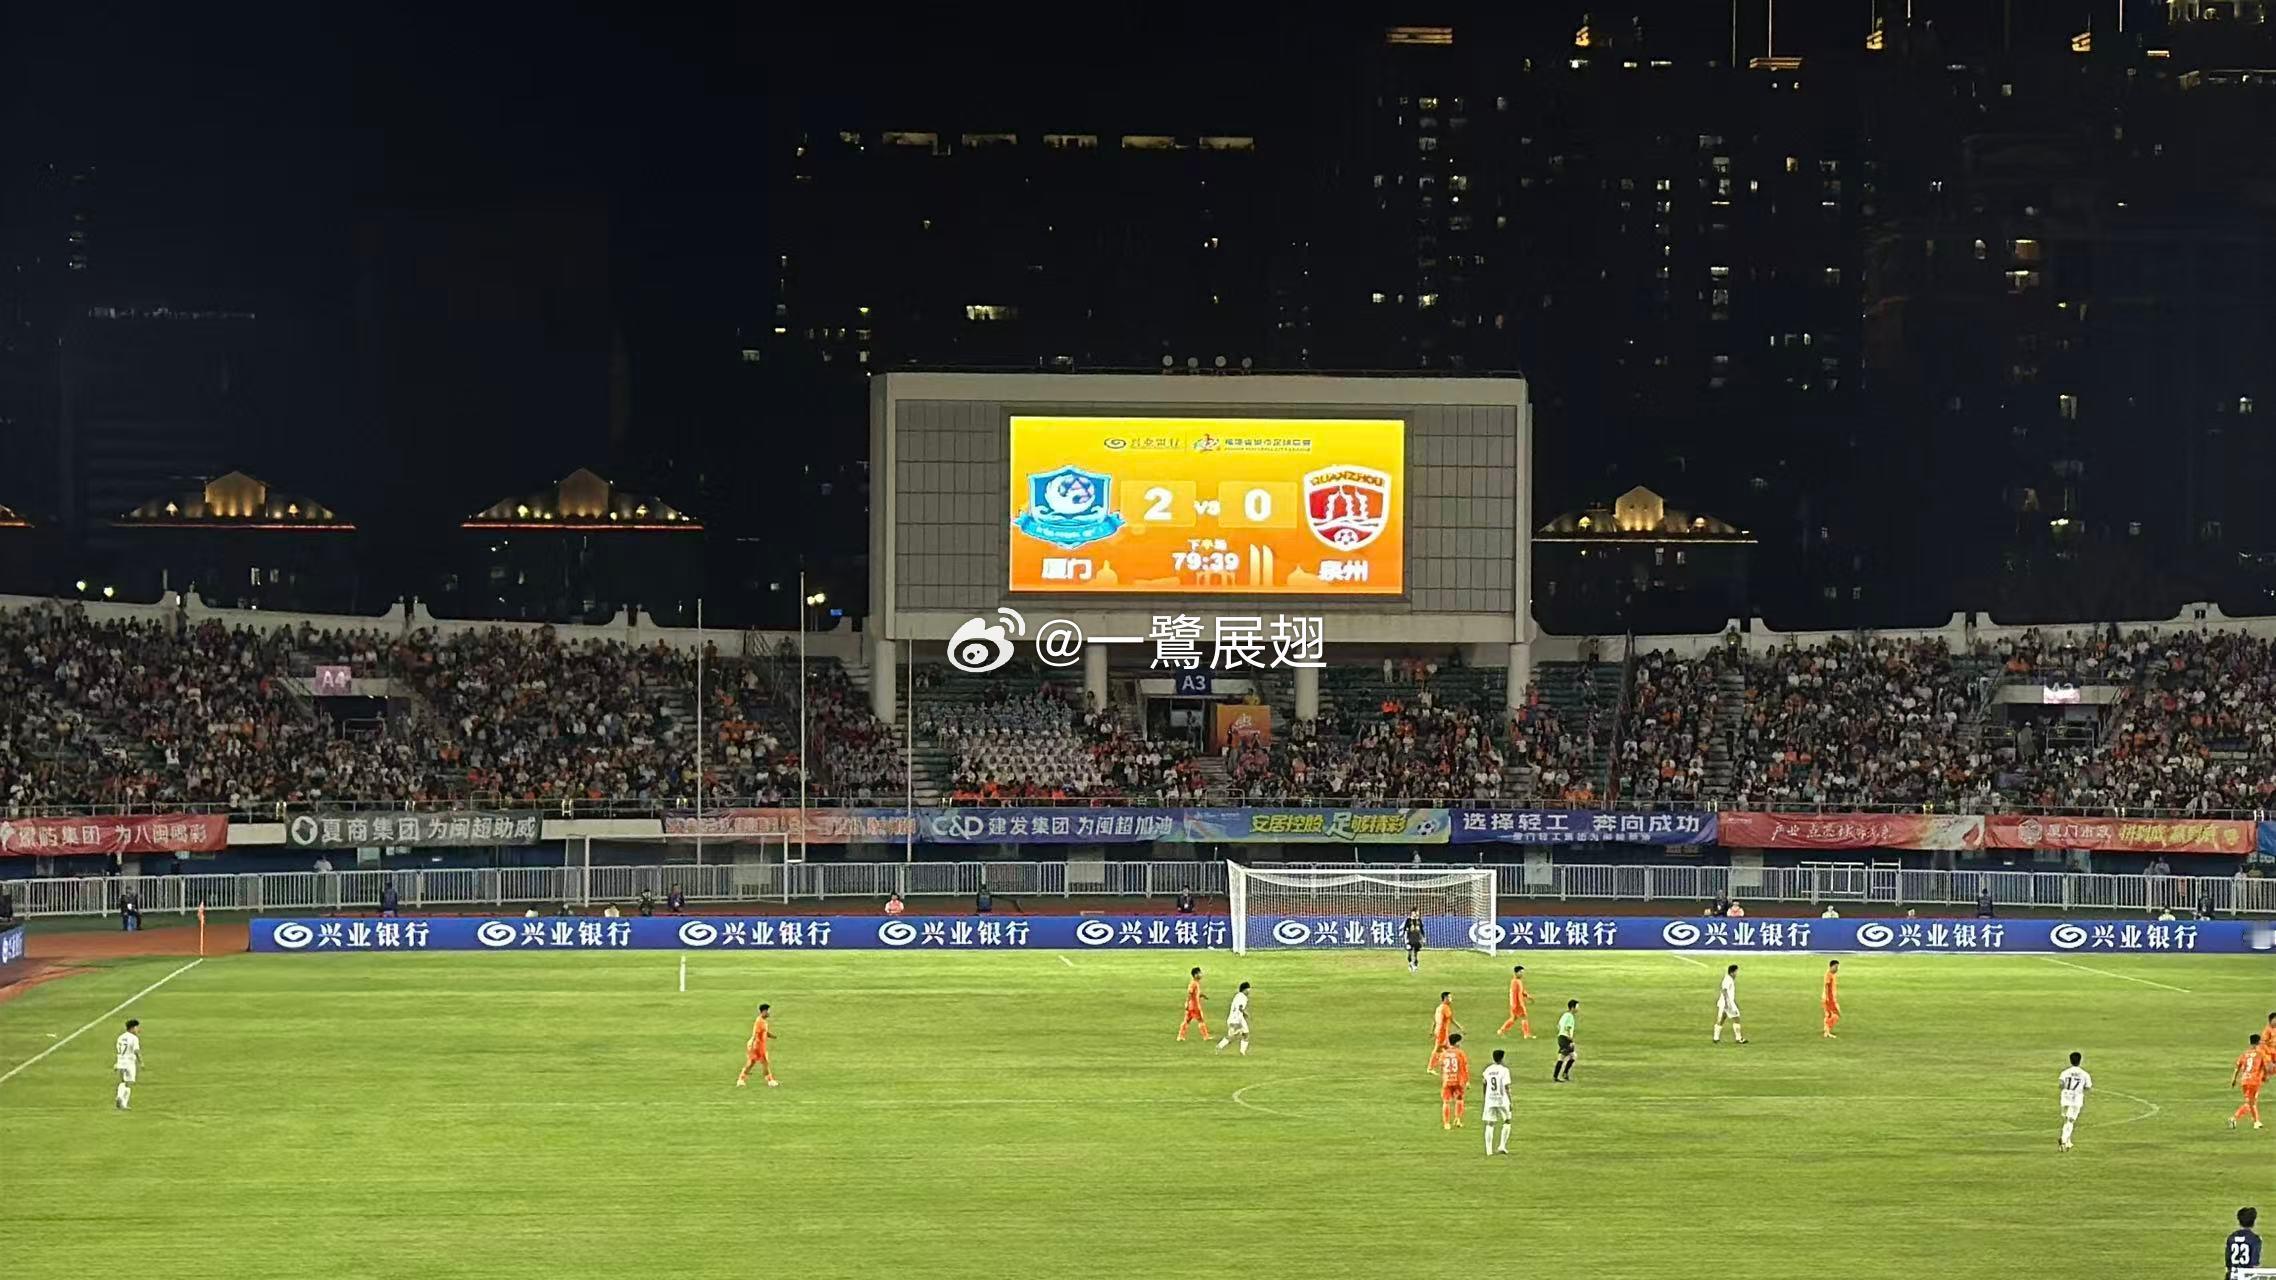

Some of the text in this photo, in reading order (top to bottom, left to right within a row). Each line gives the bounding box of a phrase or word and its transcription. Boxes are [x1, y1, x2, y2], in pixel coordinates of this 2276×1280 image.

[1311, 471, 1384, 486] QUANZHOU
[1144, 488, 1172, 521] 2
[1244, 489, 1271, 521] 0
[1172, 552, 1239, 572] 79:39
[322, 670, 346, 688] A4
[1182, 674, 1206, 690] A3
[321, 816, 536, 842] 夏商集团 为闽超助威
[932, 815, 984, 839] C&D
[988, 816, 1069, 836] 建发集团
[1077, 815, 1173, 837] 为闽超加油
[1251, 811, 1407, 840] 安居控股 足够精彩
[1463, 813, 1700, 833] 选择轻工 奔向成功
[318, 922, 429, 947] 兴业银行
[521, 922, 632, 946] 兴业银行
[722, 921, 831, 946] 兴业银行
[921, 921, 1030, 946] 兴业银行
[1118, 920, 1226, 945] 兴业银行
[1314, 920, 1408, 945] 兴业银
[1510, 921, 1618, 946] 兴业银行
[1704, 922, 1811, 947] 兴业银行
[1898, 923, 2005, 948] 兴业银行
[2092, 924, 2198, 949] 兴业银行
[1490, 1076, 1498, 1092] 9
[2065, 1077, 2081, 1090] 17
[2231, 1243, 2250, 1265] 23
